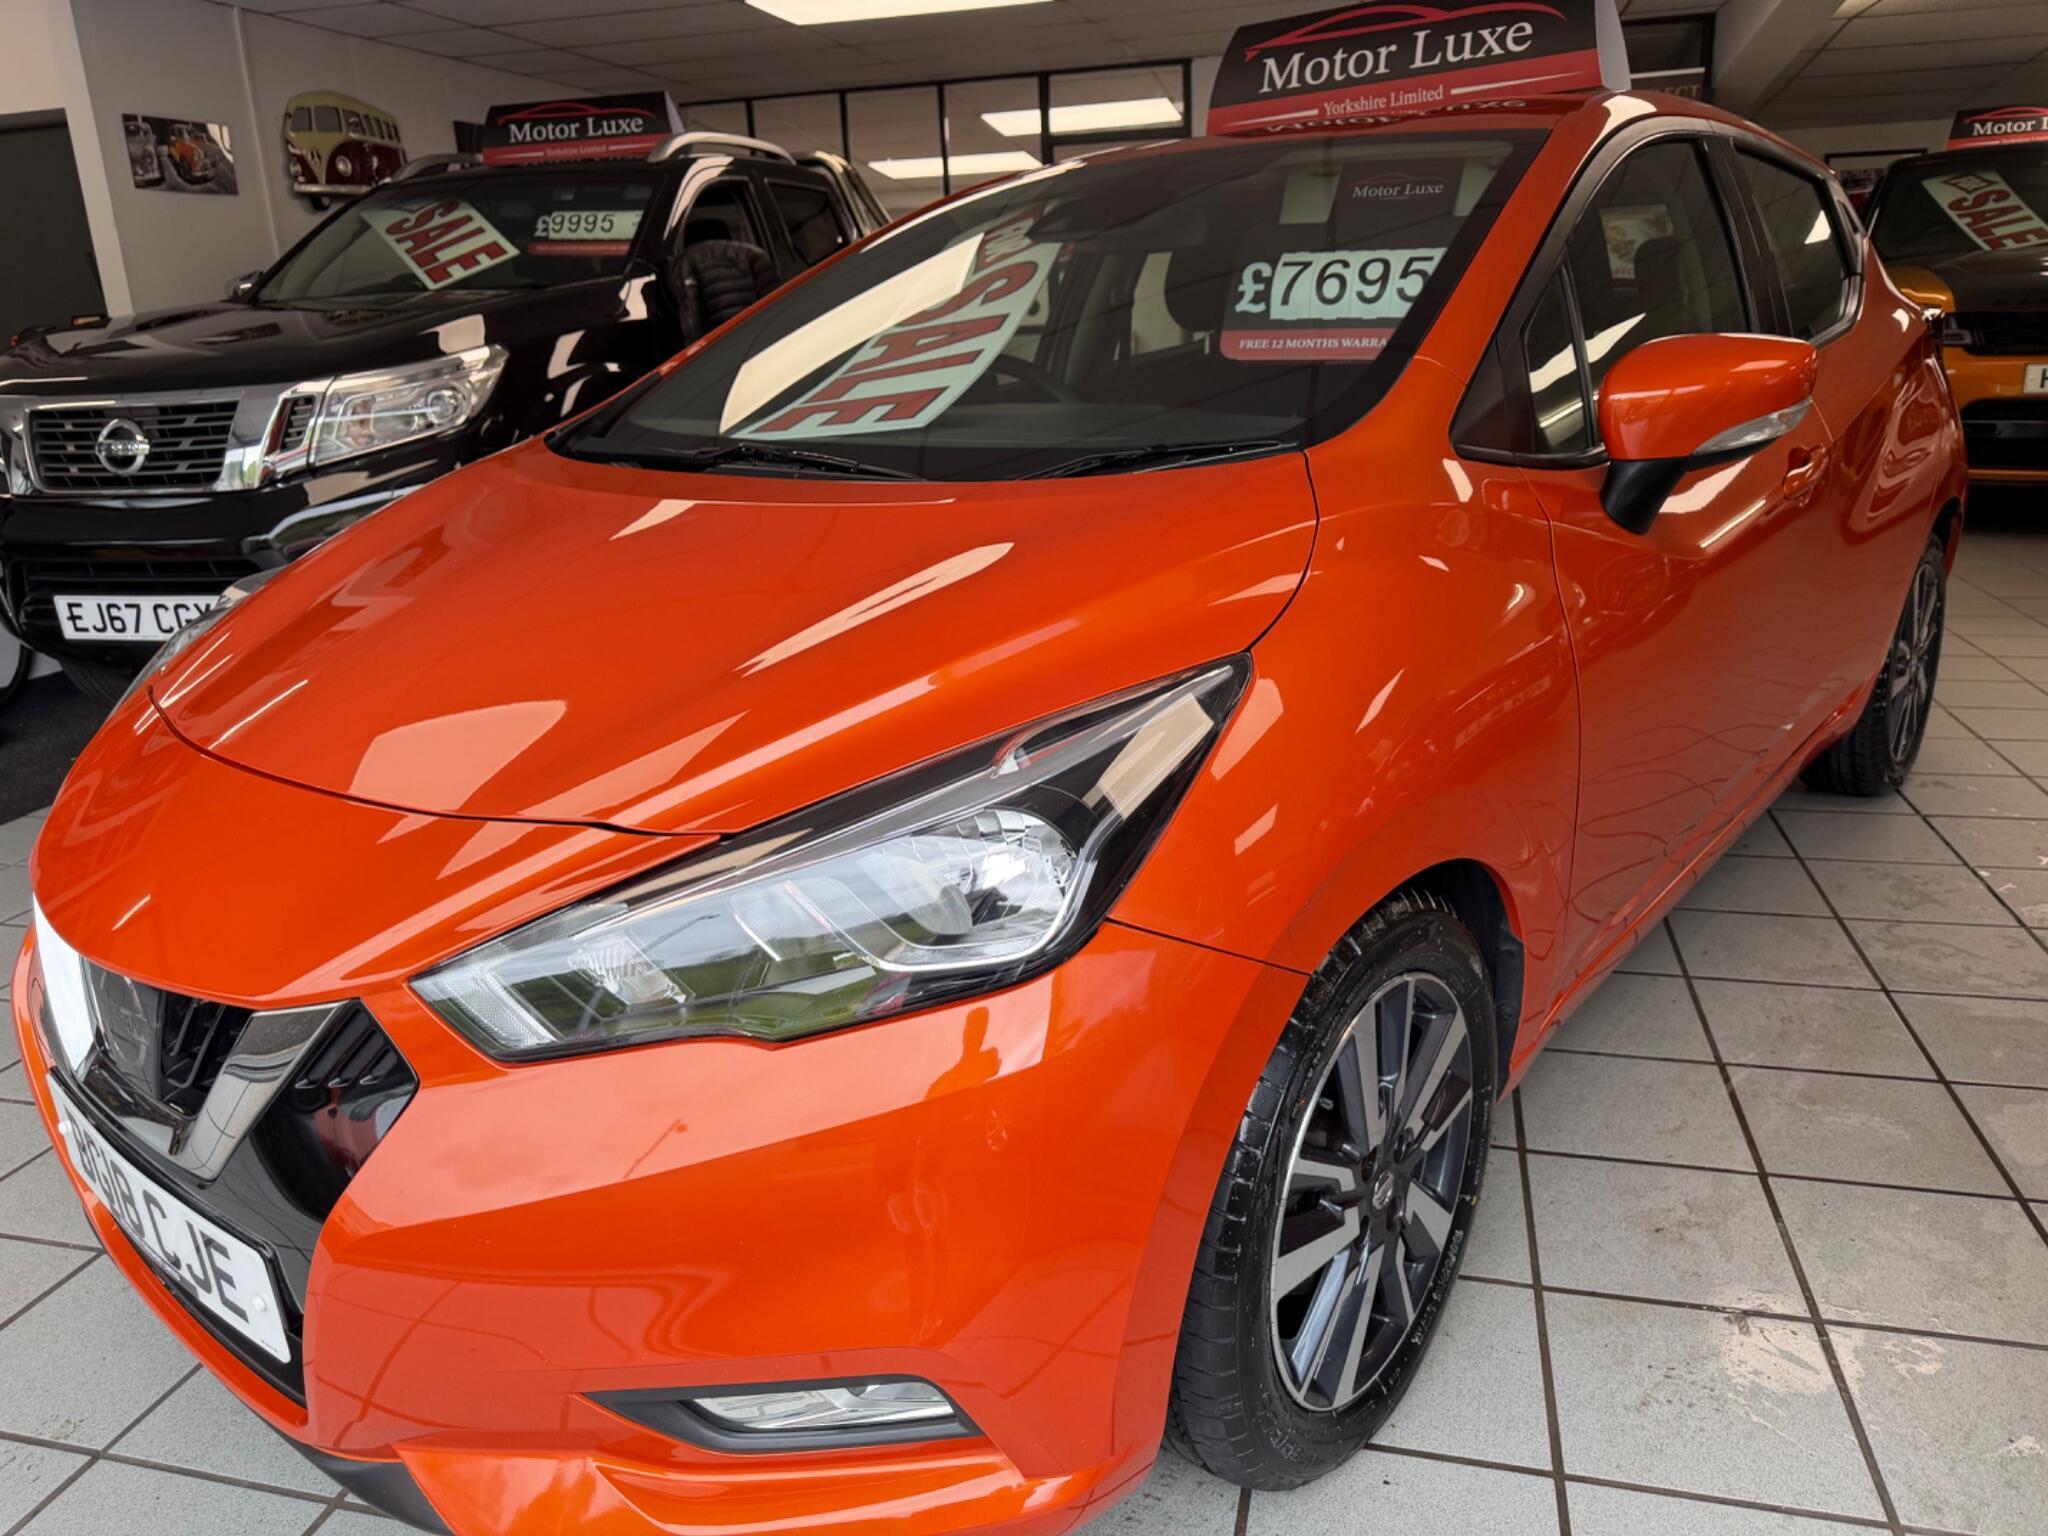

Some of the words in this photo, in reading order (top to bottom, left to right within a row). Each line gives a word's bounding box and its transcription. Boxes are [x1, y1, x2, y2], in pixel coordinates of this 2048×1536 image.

[1258, 43, 1398, 94] Motor
[1408, 21, 1534, 69] Luxe
[1323, 96, 1387, 116] Yorkshire
[1390, 84, 1444, 107] Limited
[508, 121, 580, 144] Motor
[586, 116, 645, 138] Luxe
[1971, 119, 2037, 137] Motor
[1351, 184, 1402, 199] Motor
[1404, 183, 1445, 196] Luxe
[534, 212, 616, 238] £9995
[1947, 189, 2048, 251] SALE
[384, 200, 508, 285] SALE
[1234, 255, 1437, 314] £7695
[748, 260, 1040, 434] SALE
[1239, 338, 1270, 350] FREE
[1271, 338, 1285, 349] 12
[1286, 337, 1338, 349] MONTHS
[66, 602, 142, 633] EJ67
[142, 1189, 250, 1325] CJE
